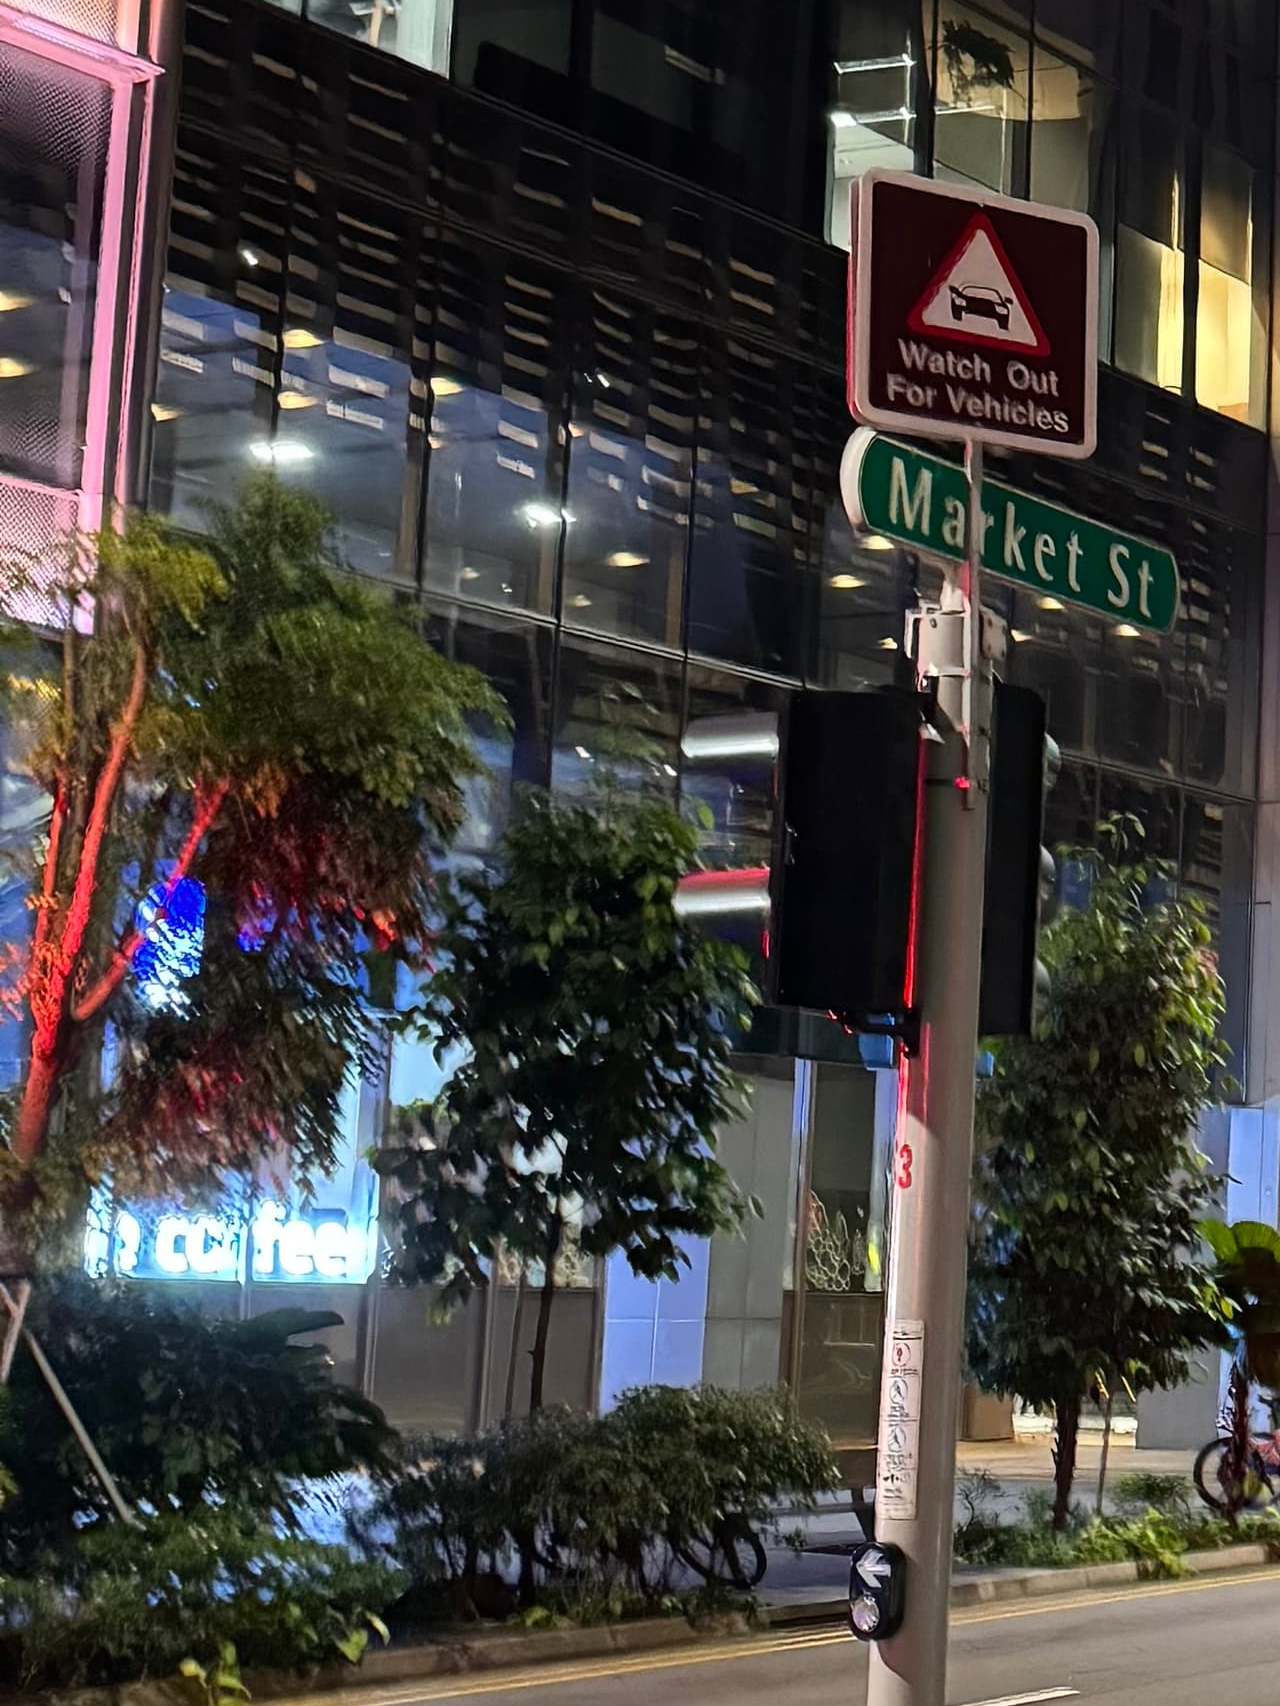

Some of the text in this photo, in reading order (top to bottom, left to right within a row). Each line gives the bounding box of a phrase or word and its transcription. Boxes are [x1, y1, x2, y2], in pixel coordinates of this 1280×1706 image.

[897, 337, 1059, 397] Watch Out
[887, 373, 1070, 434] For Vehicles
[888, 456, 1155, 620] Market St
[898, 1143, 913, 1190] 3
